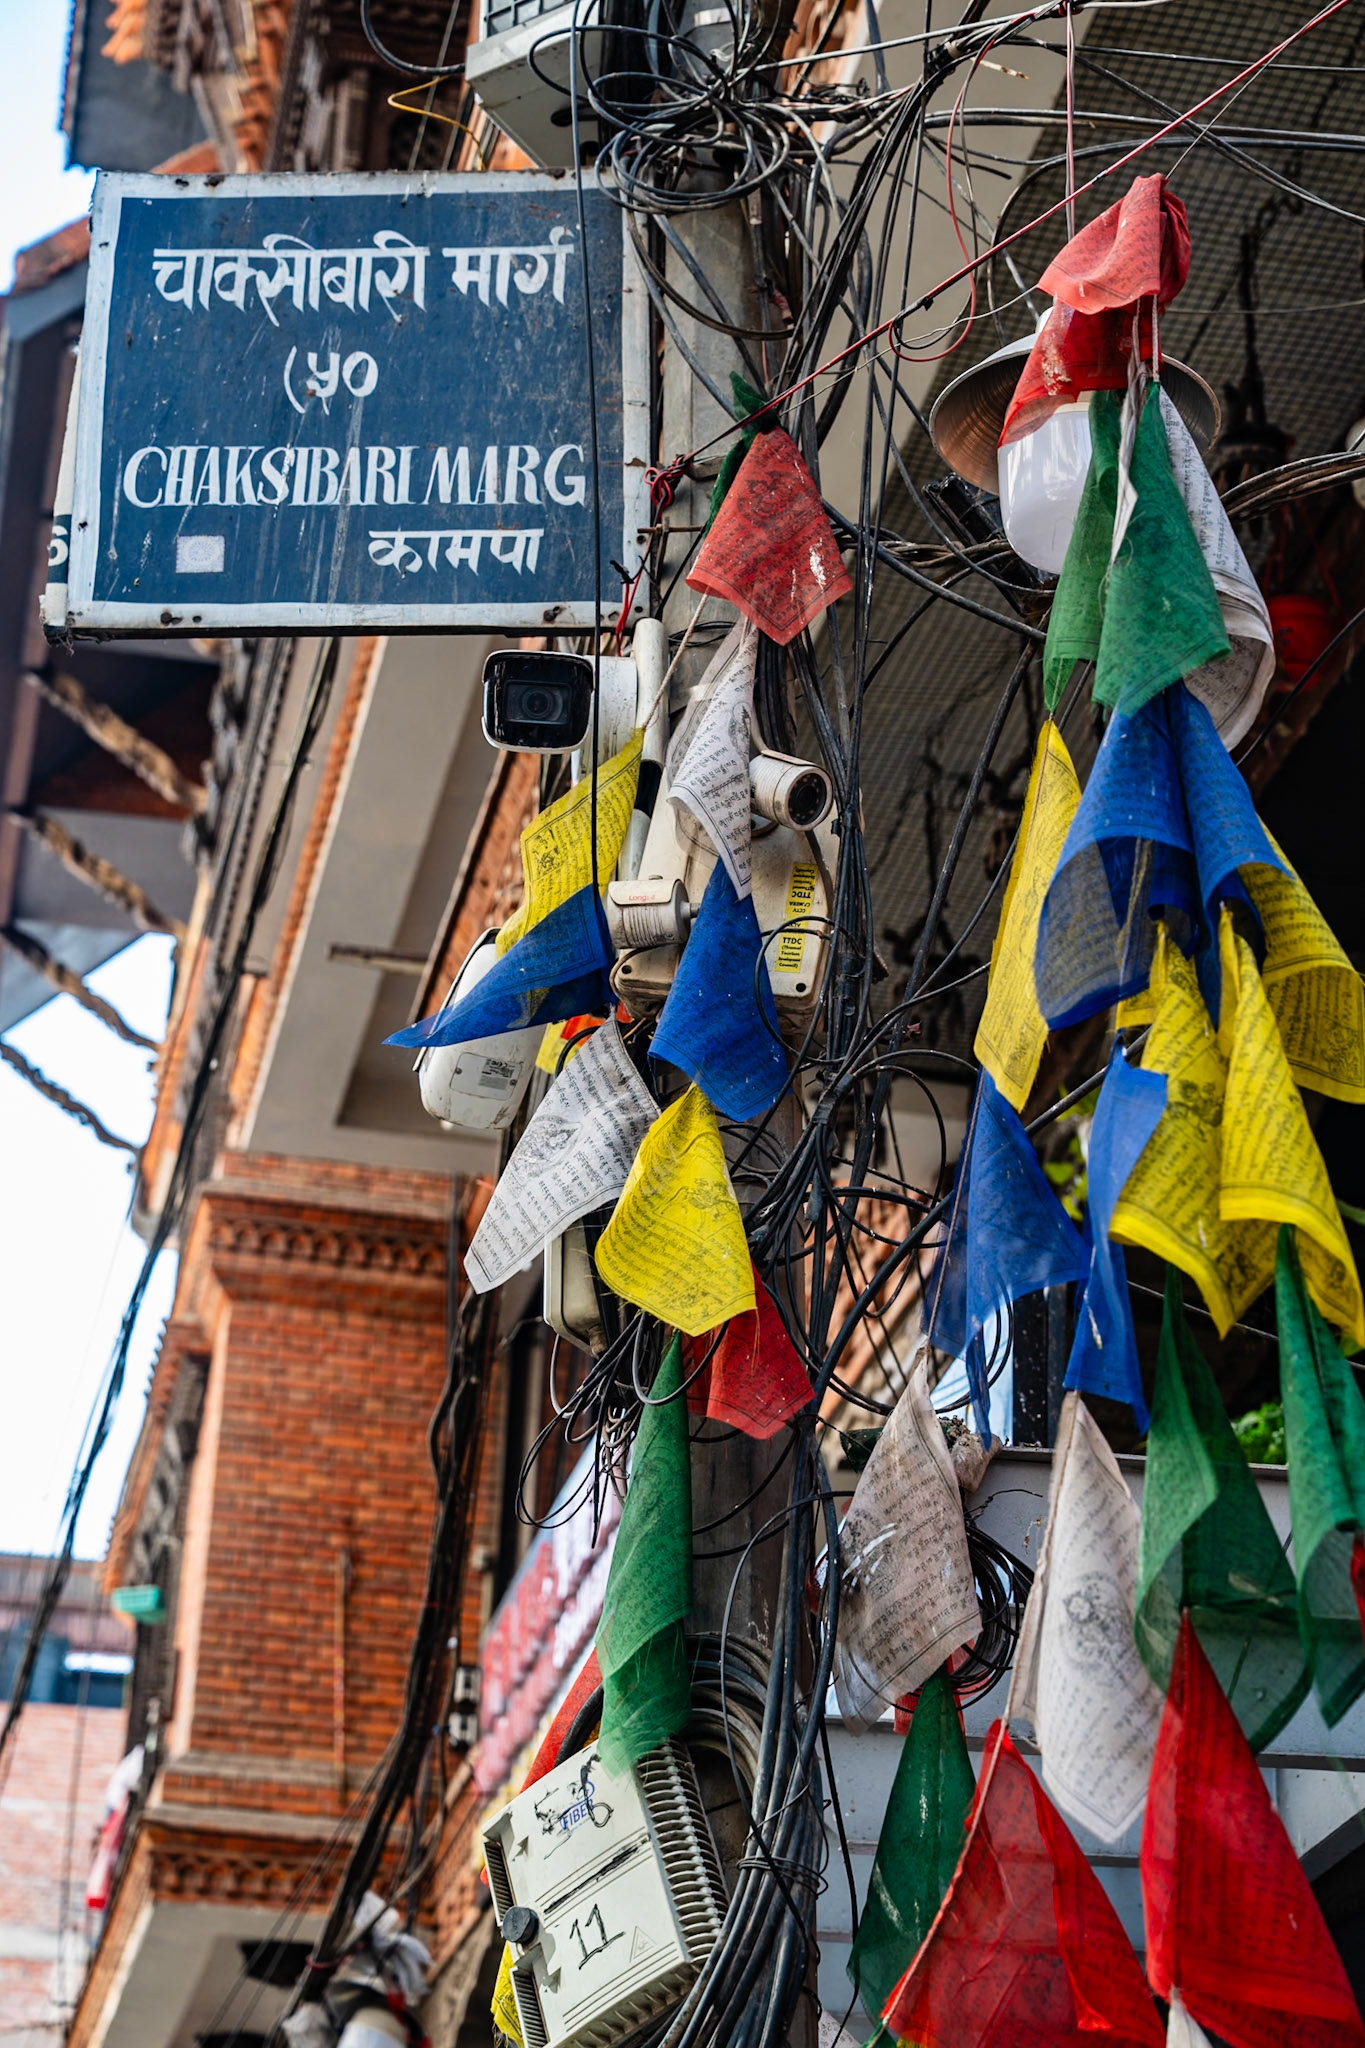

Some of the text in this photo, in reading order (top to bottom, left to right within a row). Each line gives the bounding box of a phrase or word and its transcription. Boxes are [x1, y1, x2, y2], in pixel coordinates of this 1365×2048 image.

[152, 225, 575, 328] चाक्सीबारी मार्ग
[122, 443, 586, 509] CHAKSIBARI MARG
[367, 527, 545, 577] कामपा
[791, 891, 812, 899] TTDC
[782, 936, 803, 945] TTDC
